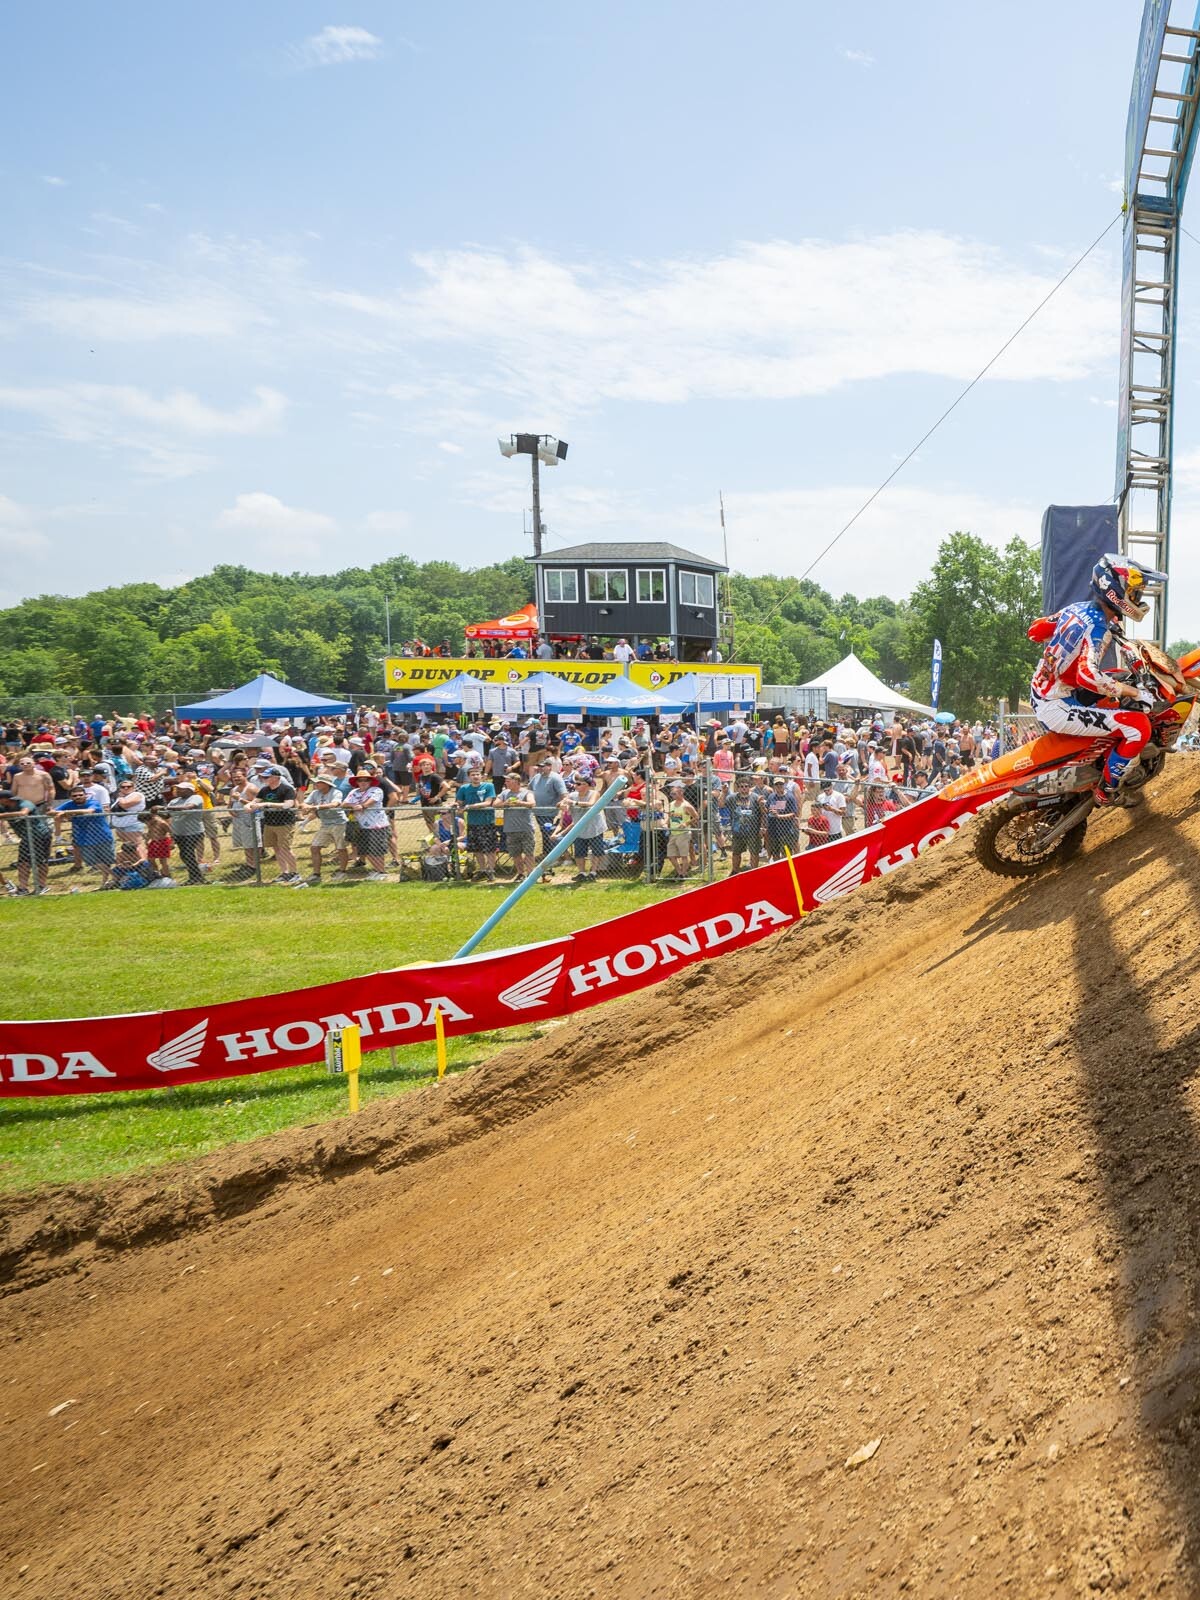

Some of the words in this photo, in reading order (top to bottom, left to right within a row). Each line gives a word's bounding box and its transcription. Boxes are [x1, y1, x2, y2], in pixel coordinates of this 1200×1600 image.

[568, 900, 793, 997] HONDA
[0, 1051, 117, 1082] DA
[216, 996, 473, 1062] HONDA
